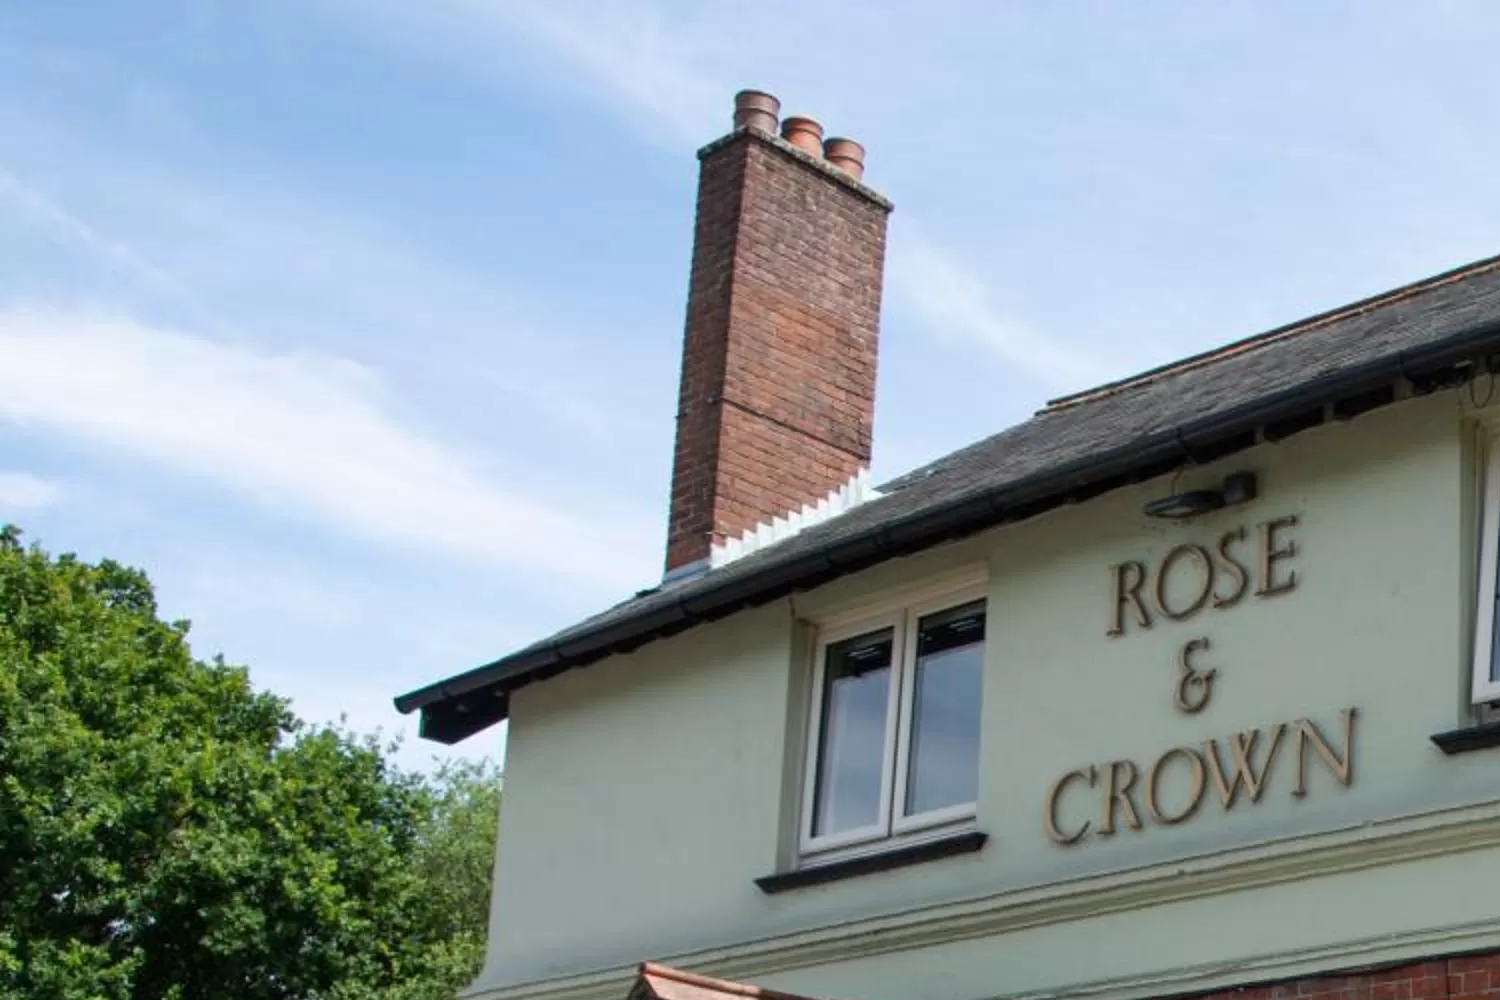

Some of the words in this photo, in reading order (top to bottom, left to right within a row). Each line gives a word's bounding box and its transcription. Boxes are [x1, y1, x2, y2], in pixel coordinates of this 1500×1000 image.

[1107, 515, 1299, 637] ROSE
[1175, 637, 1217, 713] &
[1046, 707, 1360, 846] CROWN
